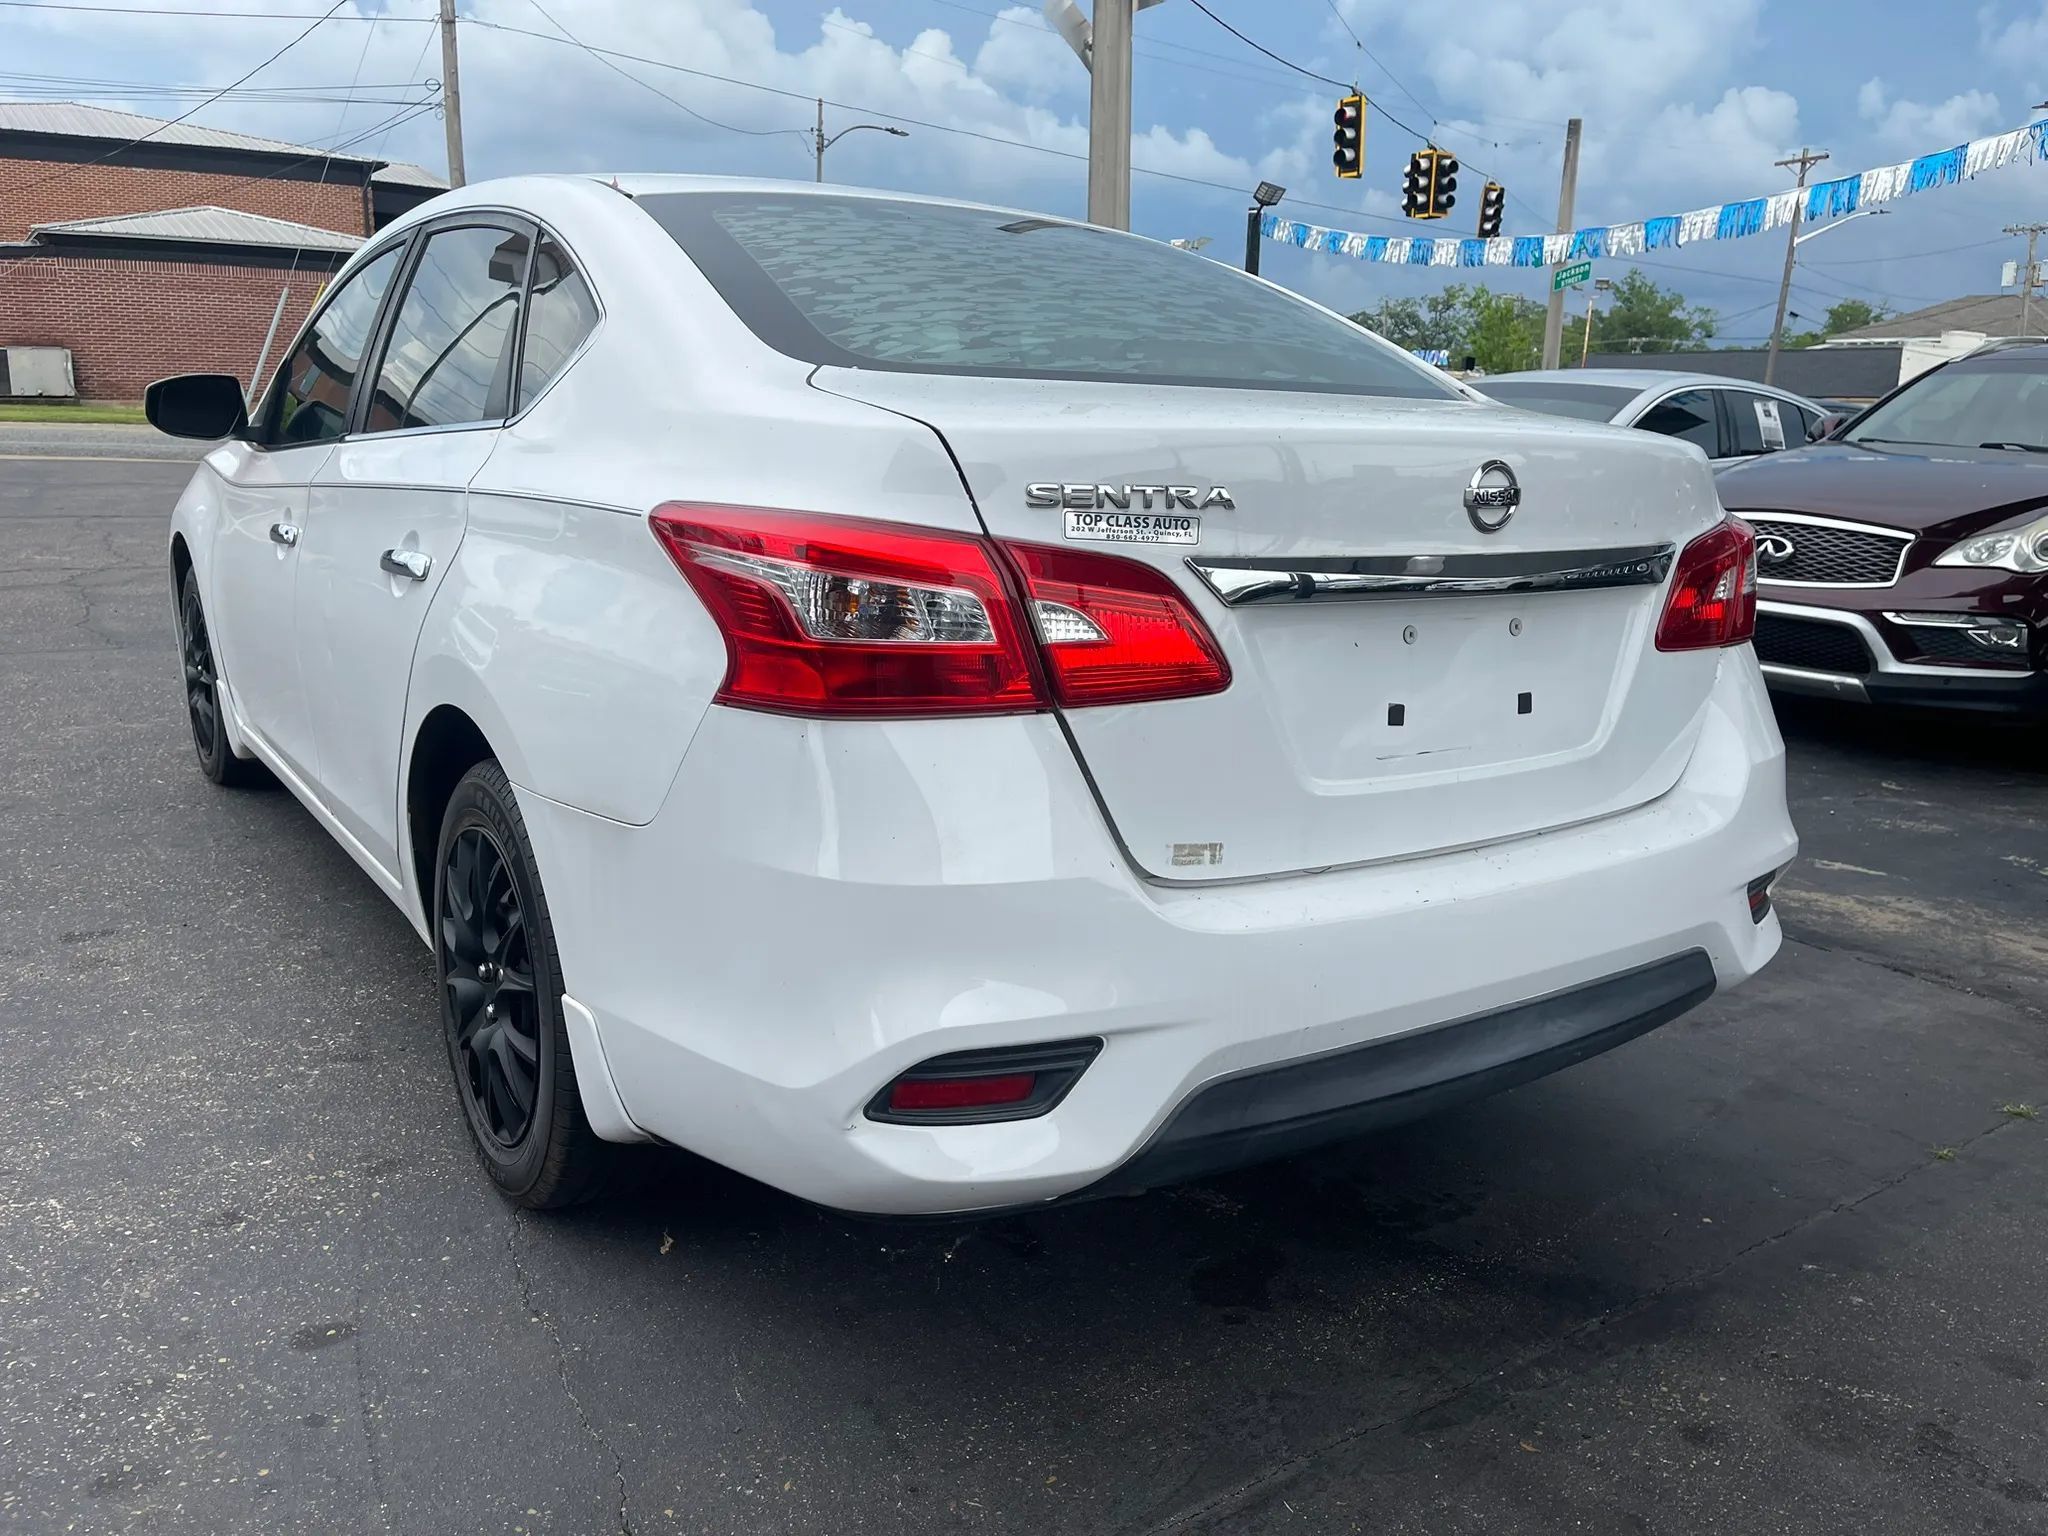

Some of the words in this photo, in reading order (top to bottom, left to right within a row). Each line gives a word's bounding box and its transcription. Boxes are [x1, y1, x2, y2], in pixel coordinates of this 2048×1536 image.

[1556, 264, 1590, 280] Jackson
[1561, 274, 1582, 287] STREET
[1026, 483, 1236, 510] SENTRA
[1473, 489, 1519, 504] NISSAN
[1074, 513, 1102, 526] TOP
[1106, 515, 1150, 528] CLASS
[1152, 517, 1191, 530] AUTO
[1096, 526, 1134, 534] Jefferson
[1153, 529, 1182, 538] Quincy,
